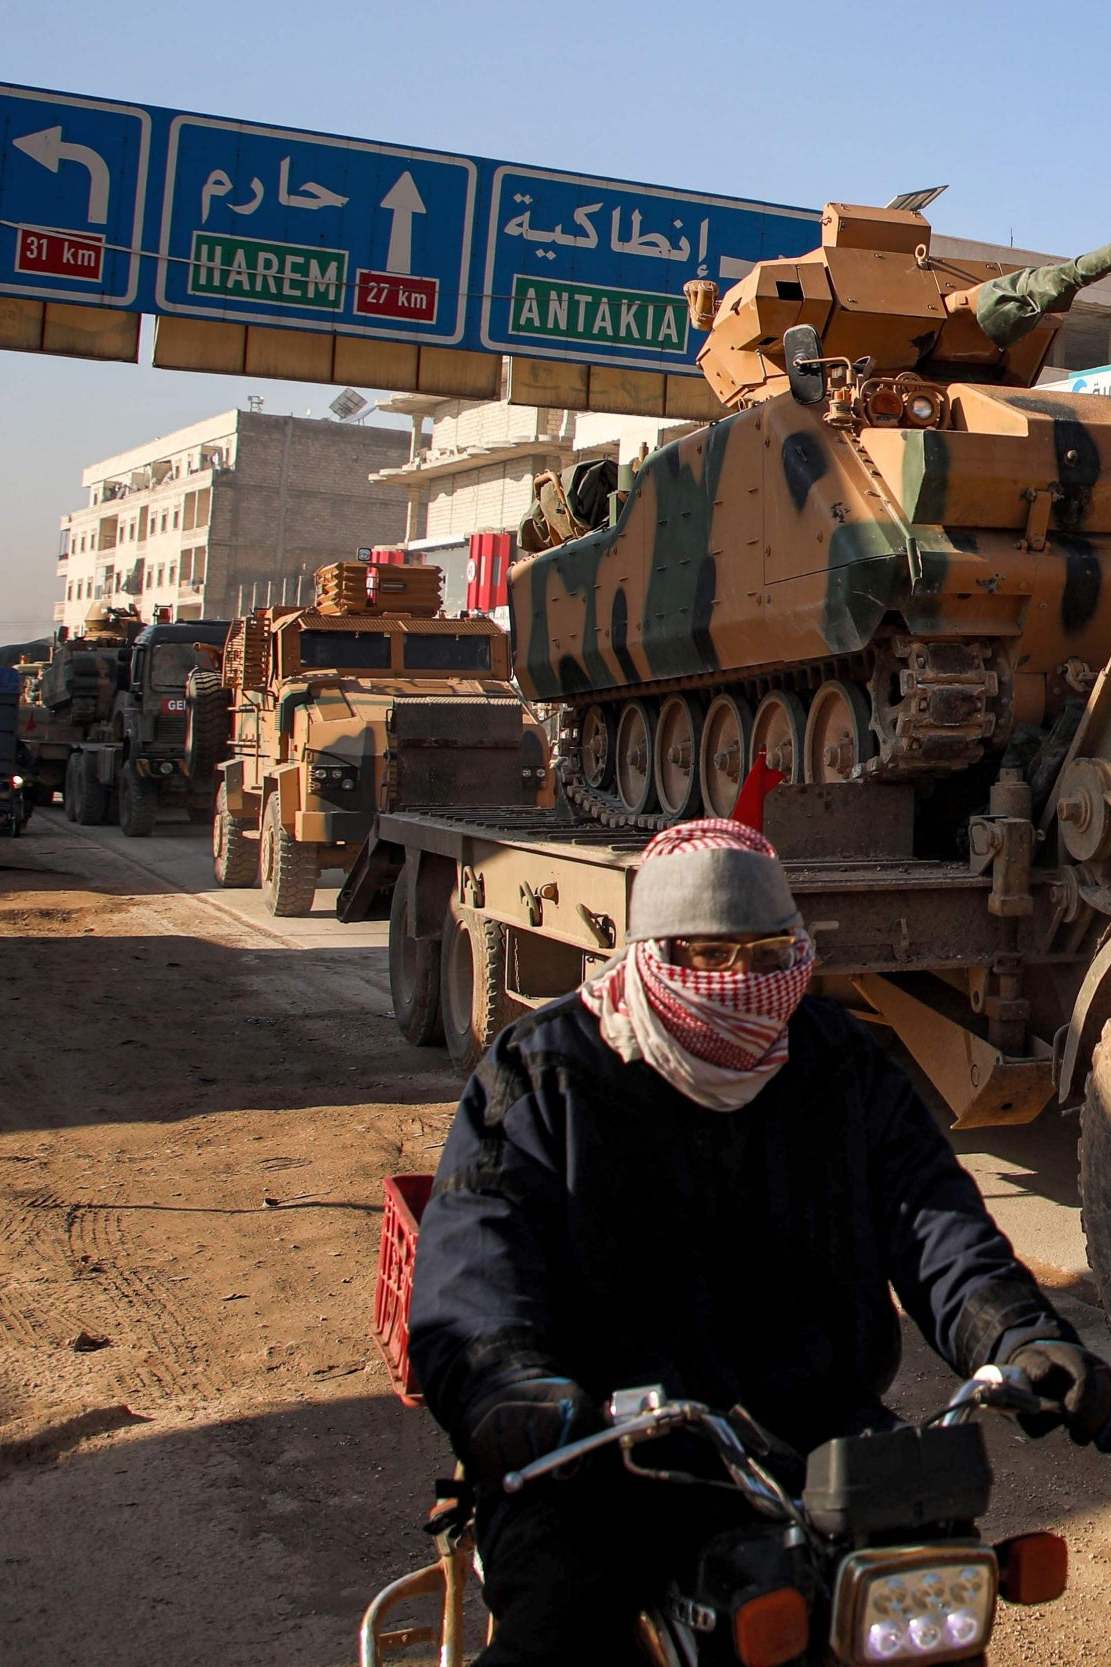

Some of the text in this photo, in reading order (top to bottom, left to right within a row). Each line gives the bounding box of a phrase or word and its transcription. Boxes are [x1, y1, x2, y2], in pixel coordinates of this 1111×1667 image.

[202, 155, 350, 225] حارم
[26, 236, 96, 267] 31 km
[504, 192, 710, 279] إنطاكية
[199, 244, 338, 300] HAREM
[367, 281, 427, 310] 27 km
[519, 287, 679, 343] ANTAKIA
[168, 700, 186, 711] GE
